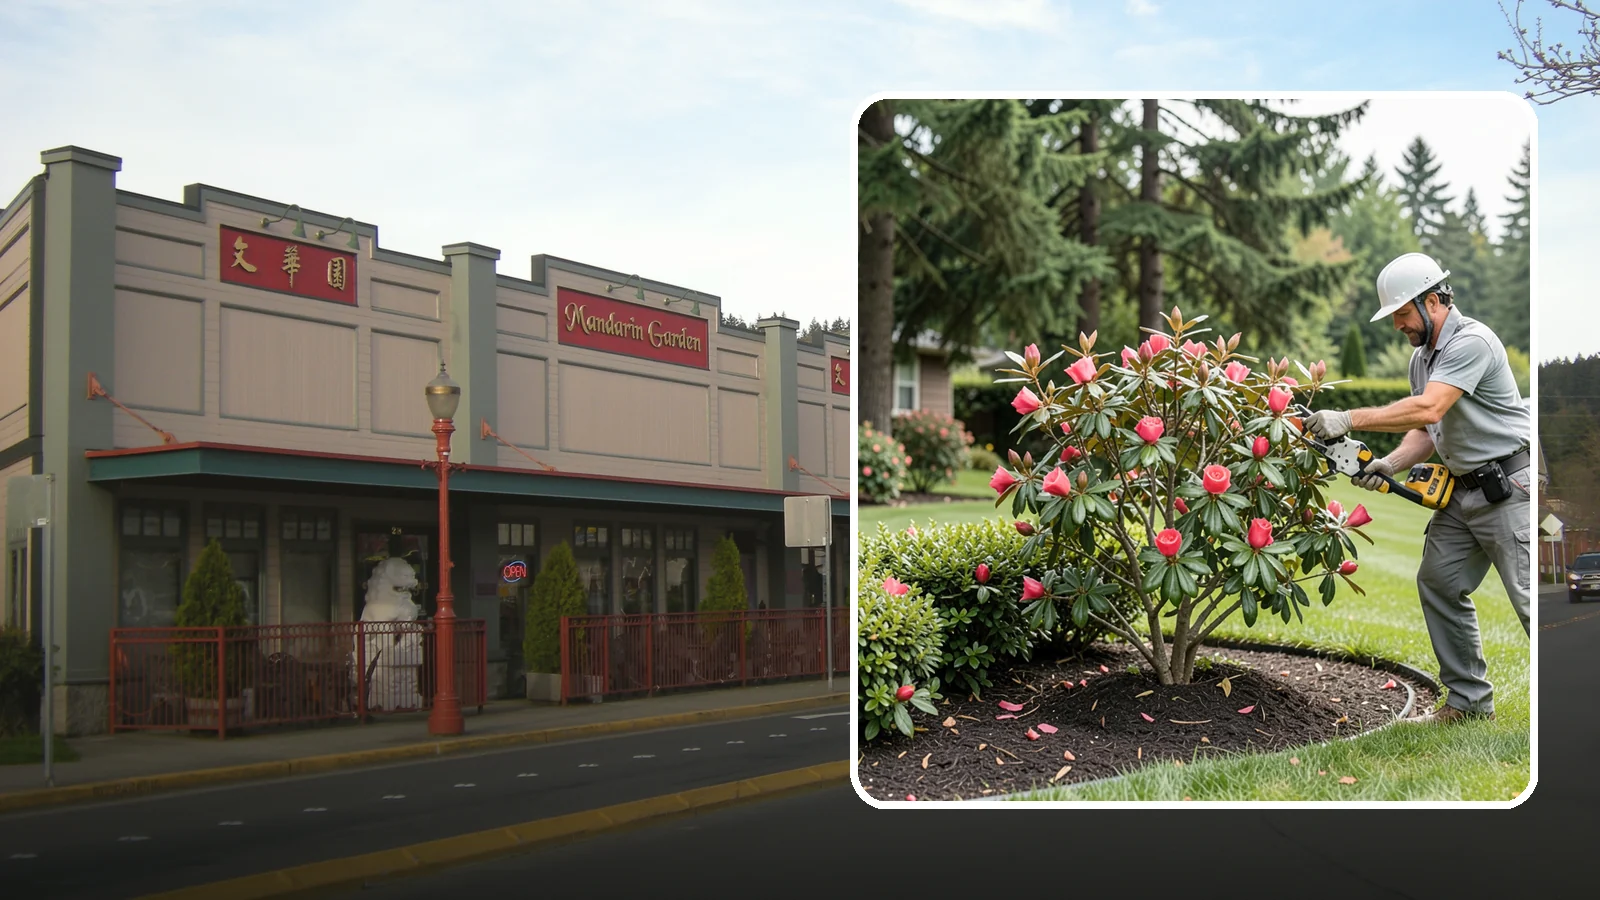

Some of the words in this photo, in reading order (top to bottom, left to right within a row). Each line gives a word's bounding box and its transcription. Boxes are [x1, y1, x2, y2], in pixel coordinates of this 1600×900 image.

[564, 302, 644, 342] Mandarin
[647, 320, 702, 352] Garden
[503, 565, 527, 578] OPEN
